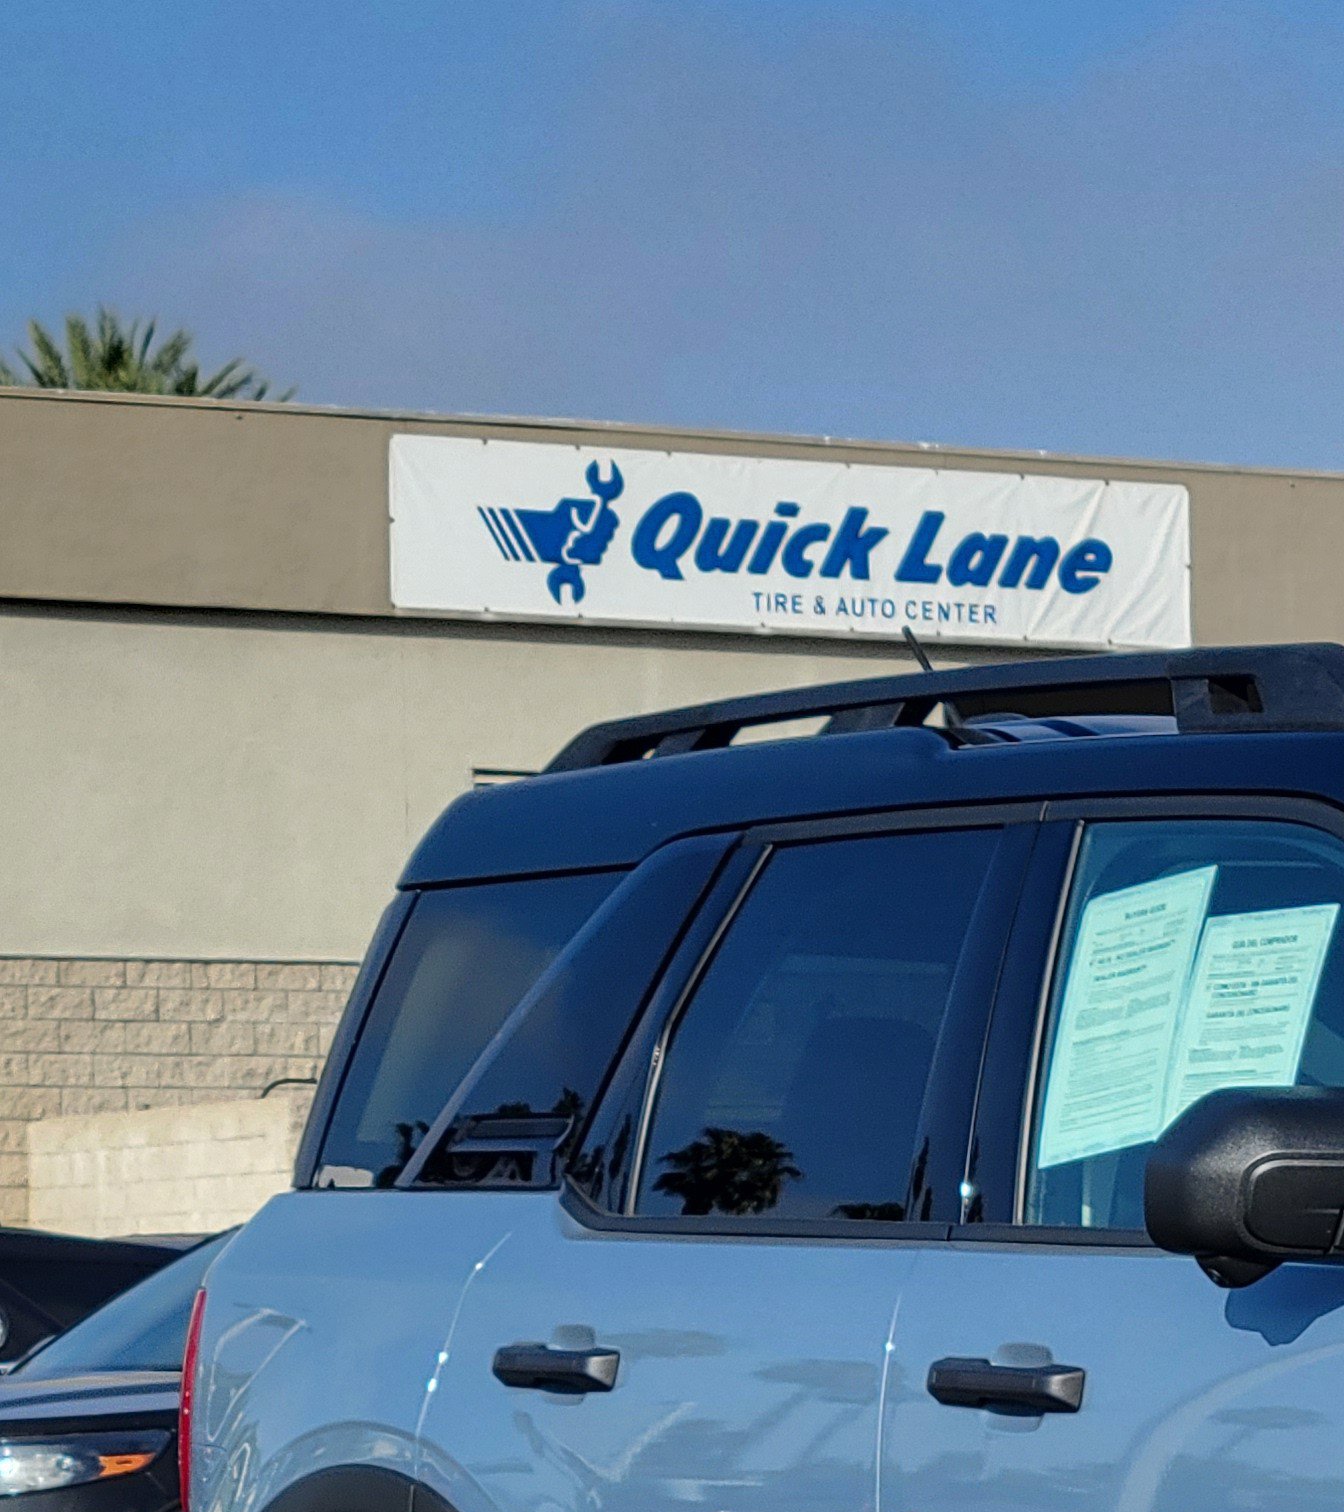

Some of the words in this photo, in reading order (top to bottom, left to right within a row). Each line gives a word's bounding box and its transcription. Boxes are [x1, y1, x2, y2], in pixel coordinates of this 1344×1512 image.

[631, 491, 889, 581] Quick
[894, 510, 1113, 594] Lane
[751, 591, 803, 615] TIRE
[813, 595, 827, 615] &
[835, 597, 896, 620] AUTO
[904, 600, 998, 625] CENTER
